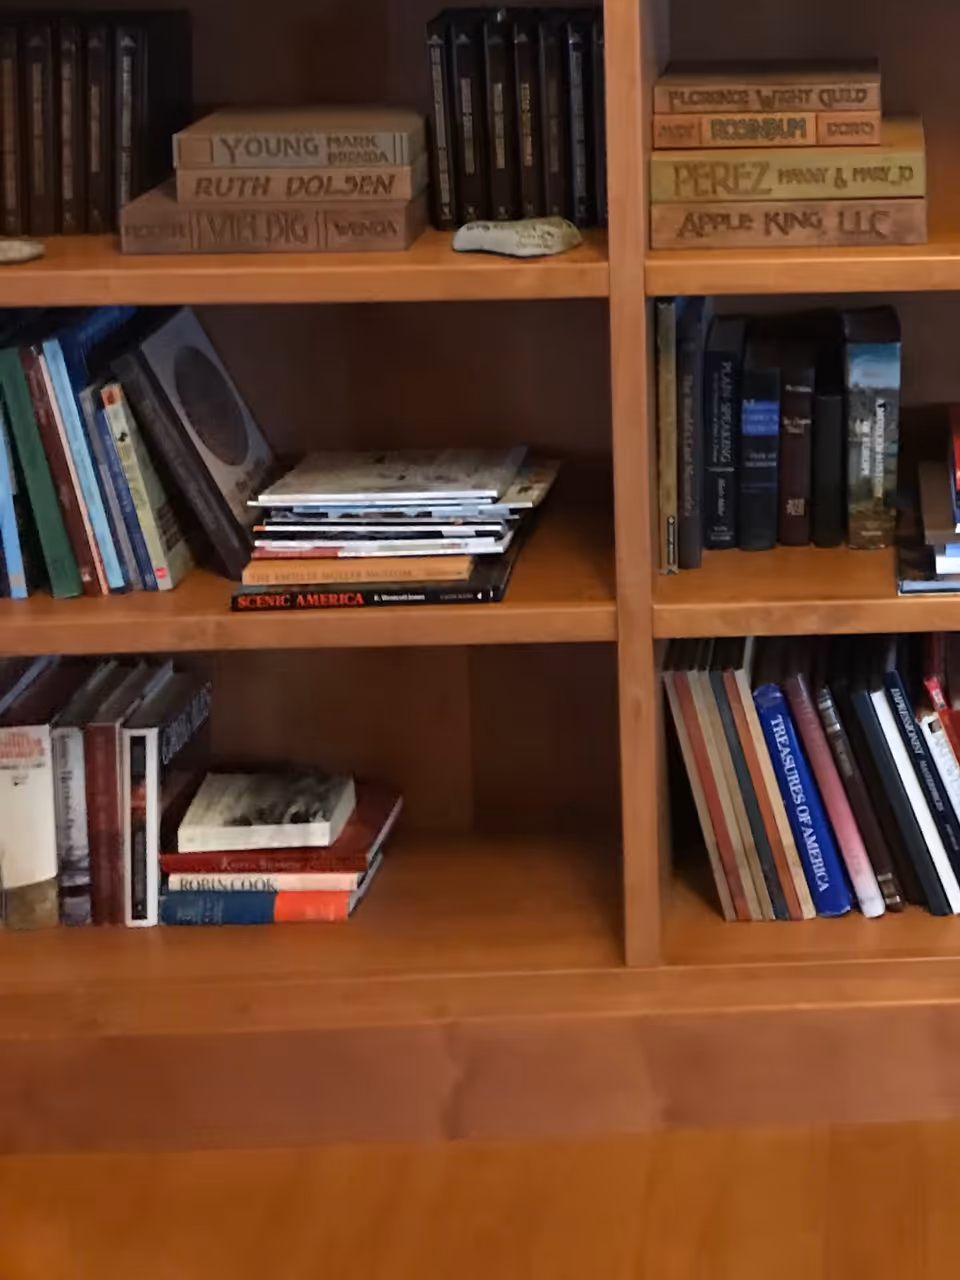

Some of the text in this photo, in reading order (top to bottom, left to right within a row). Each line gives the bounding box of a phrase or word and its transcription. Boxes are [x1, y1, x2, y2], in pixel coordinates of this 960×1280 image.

[221, 137, 319, 163] YOUNG
[326, 135, 378, 149] MARK
[194, 176, 271, 197] RUTH
[673, 160, 773, 198] PEREZ
[676, 209, 890, 239] APPLE KING LLC
[721, 360, 734, 464] PLAIN SPEAKING
[237, 592, 364, 609] SCENIC AMERICA
[890, 687, 924, 755] IMPRESSIONIST
[770, 714, 831, 893] TREASURES OF AMERICA
[180, 877, 279, 893] ROBIN COOK
